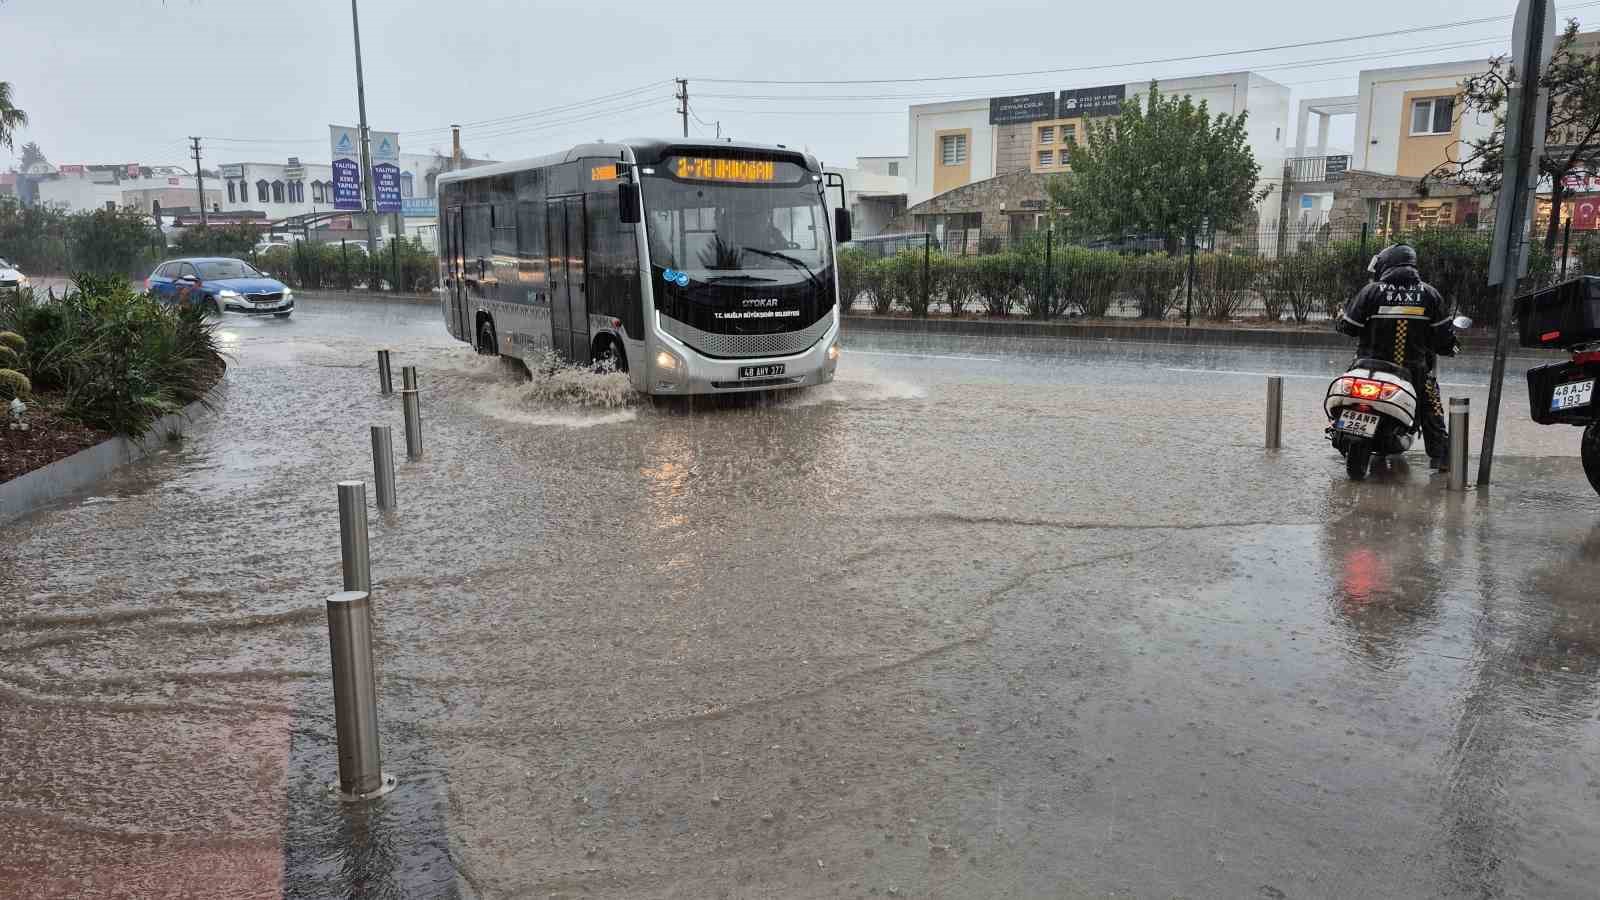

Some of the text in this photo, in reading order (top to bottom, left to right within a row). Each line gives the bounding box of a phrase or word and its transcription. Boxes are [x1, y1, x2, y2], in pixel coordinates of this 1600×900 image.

[742, 298, 778, 307] OTOKAR
[744, 367, 754, 377] 48
[1570, 382, 1591, 394] AJS
[1563, 394, 1581, 406] 193
